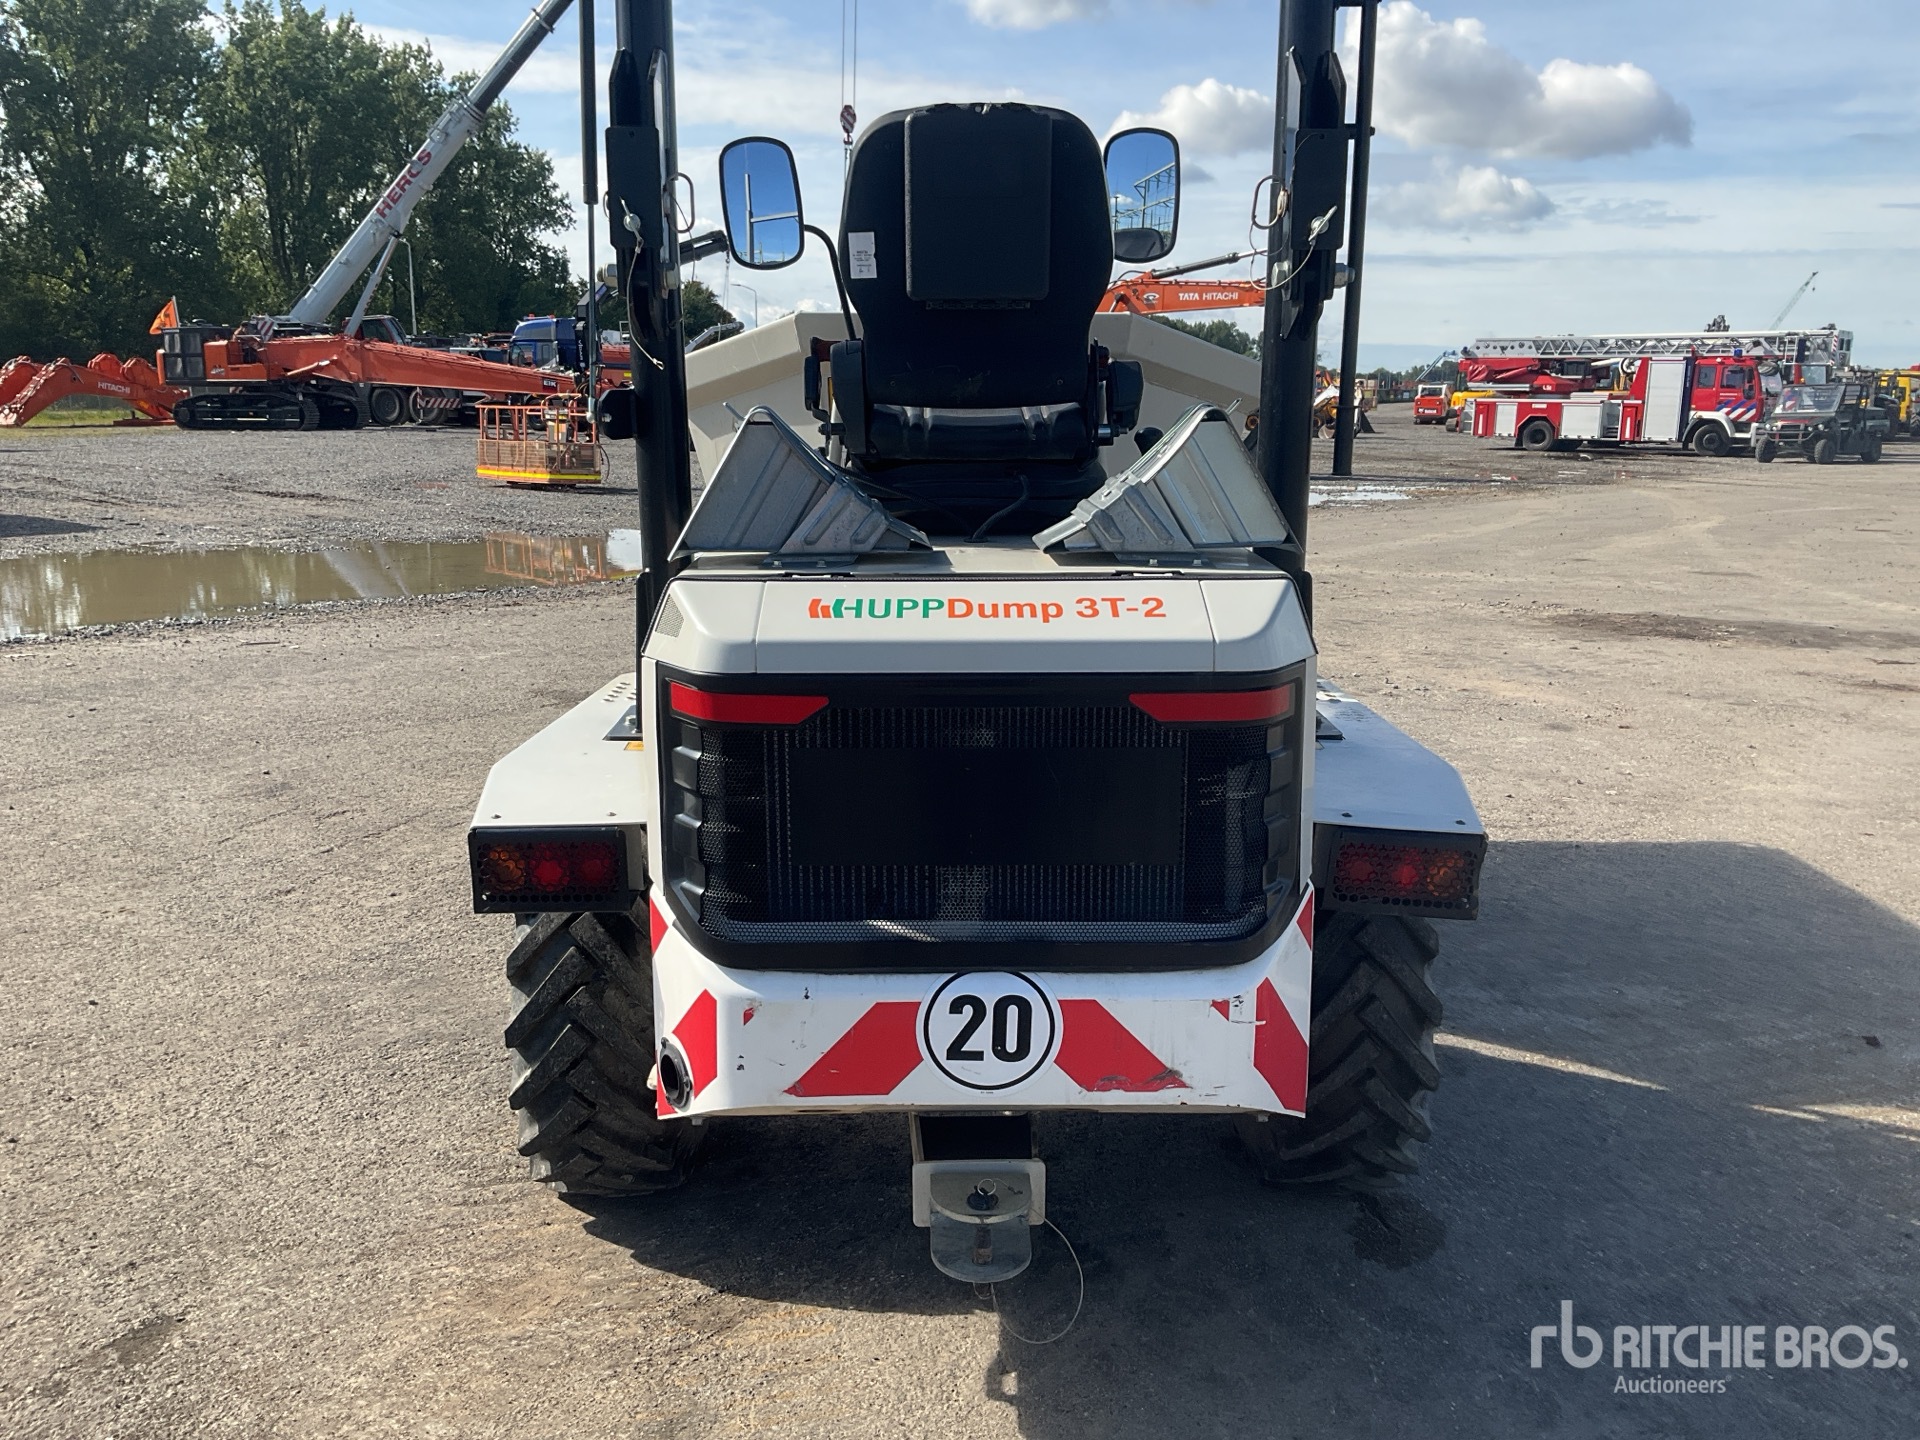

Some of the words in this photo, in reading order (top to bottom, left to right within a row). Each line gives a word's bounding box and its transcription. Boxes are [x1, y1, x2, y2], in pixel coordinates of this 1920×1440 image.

[1178, 292, 1200, 301] TATA
[1202, 291, 1239, 300] HITACHI
[97, 381, 131, 394] HITACHI
[1074, 597, 1167, 618] 3T-2
[945, 994, 1033, 1063] 20
